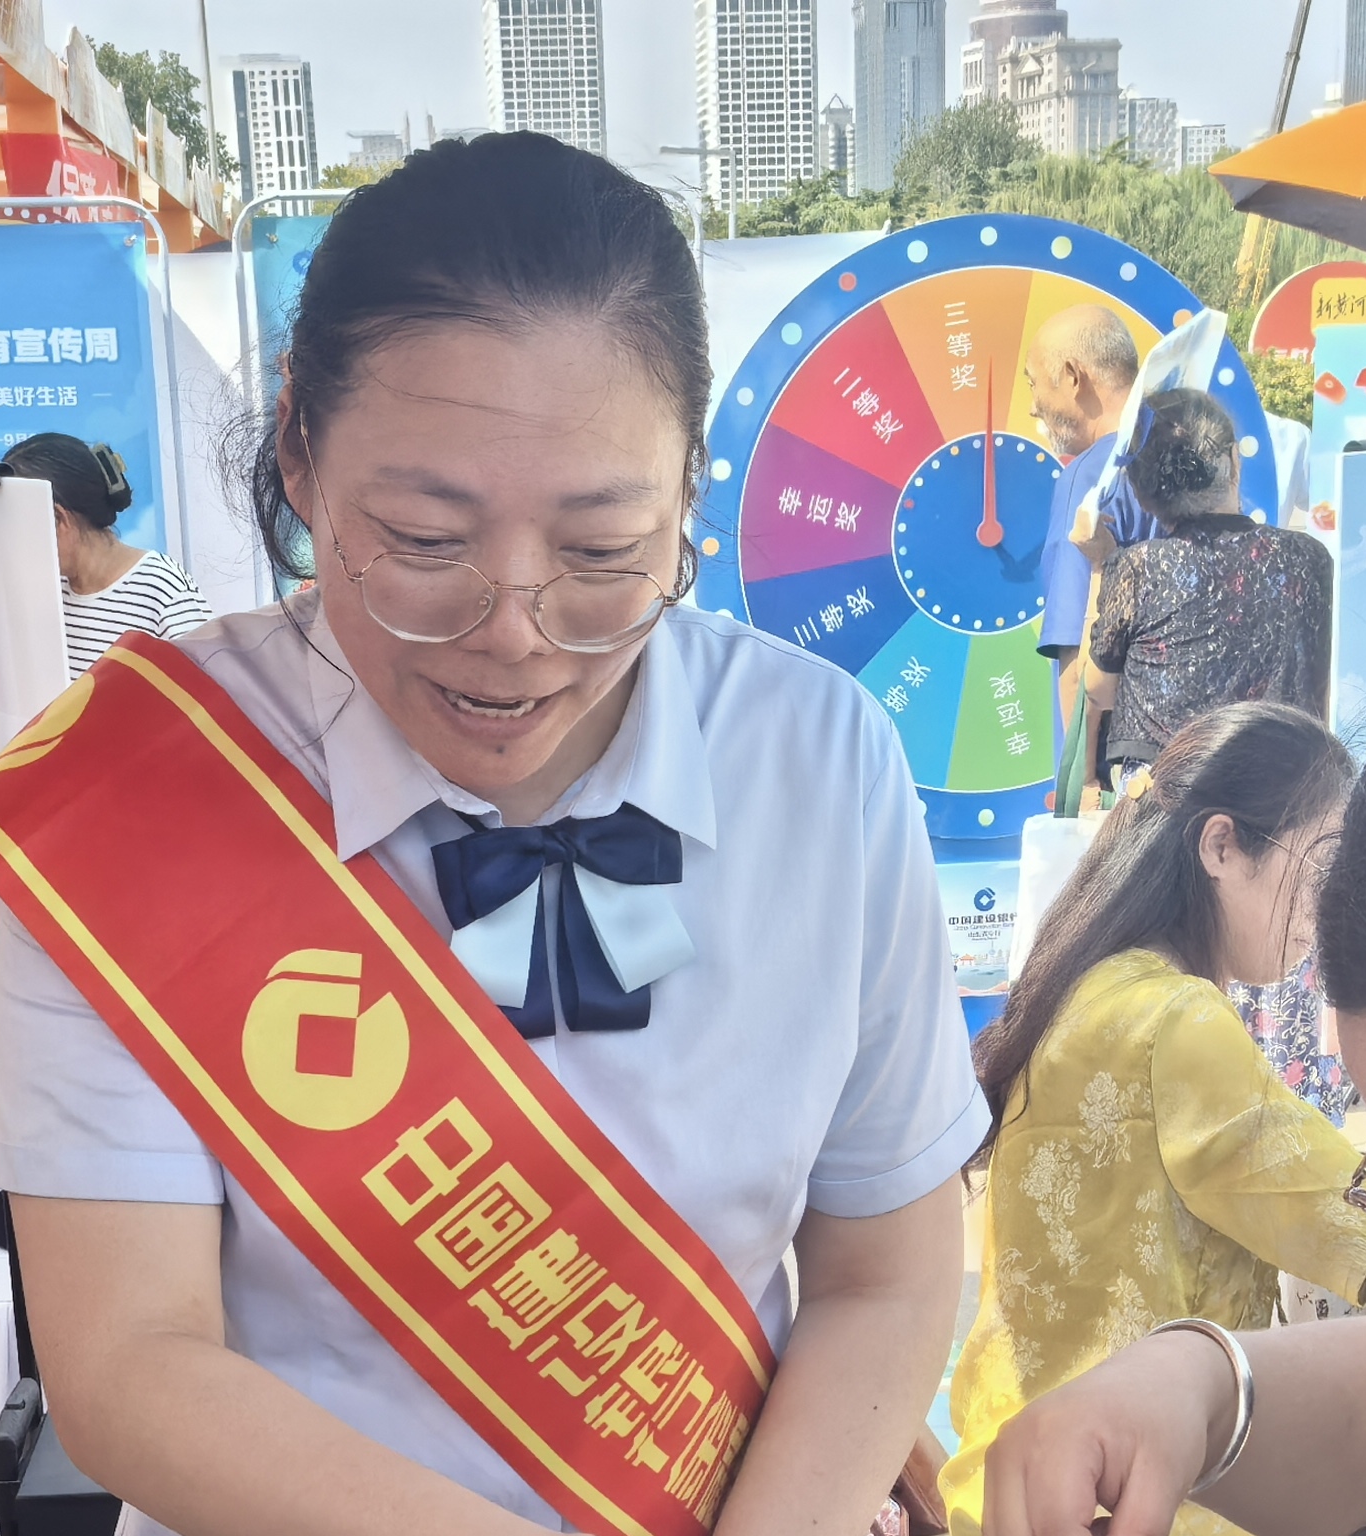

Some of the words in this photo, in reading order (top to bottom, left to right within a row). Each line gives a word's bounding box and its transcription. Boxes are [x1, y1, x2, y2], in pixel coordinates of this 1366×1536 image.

[943, 301, 977, 391] 三等奖
[834, 367, 905, 443] 二等奖
[778, 486, 862, 533] 幸运奖
[793, 585, 876, 646] 三等奖
[881, 656, 933, 714] 等奖
[989, 670, 1033, 756] 幸运奖
